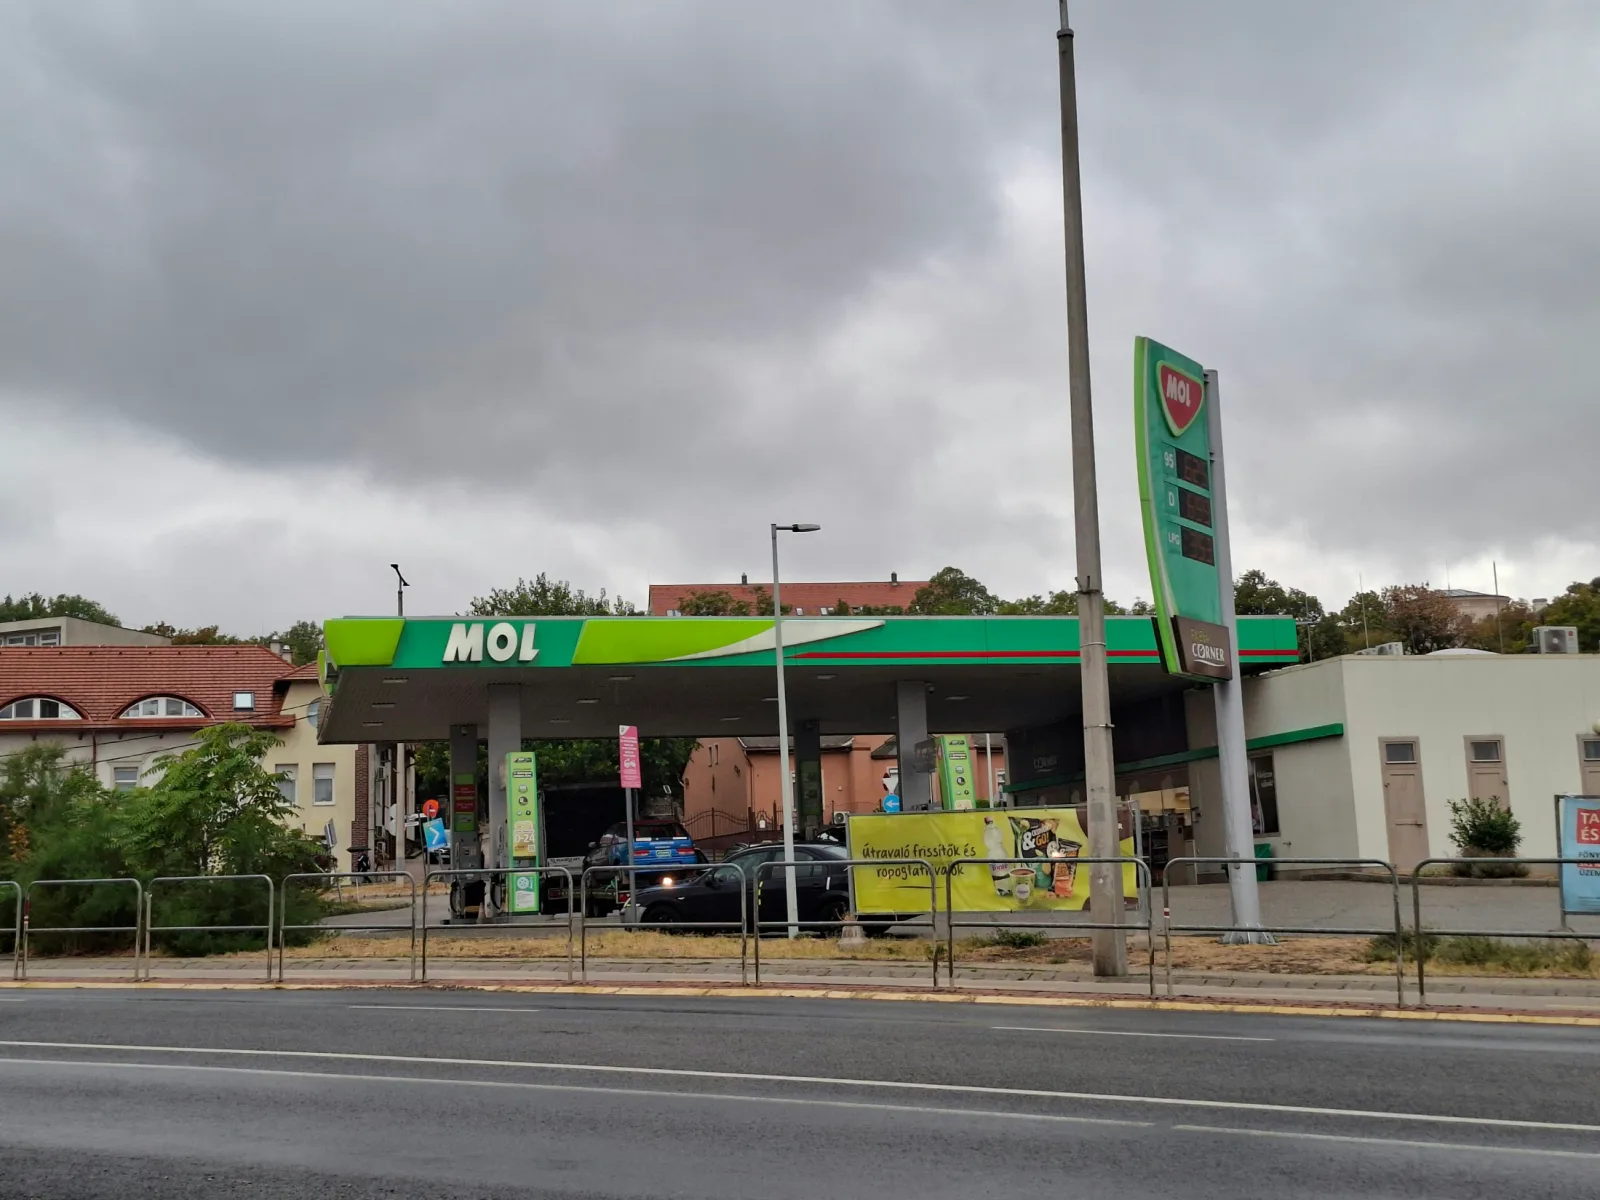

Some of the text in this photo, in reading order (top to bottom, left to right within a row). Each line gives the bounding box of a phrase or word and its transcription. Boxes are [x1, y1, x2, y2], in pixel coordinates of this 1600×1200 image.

[1166, 374, 1191, 408] MOL
[1163, 451, 1174, 469] 95
[1168, 491, 1175, 507] D
[1168, 532, 1180, 546] LPG
[442, 622, 540, 662] MOL
[1191, 643, 1225, 662] CORNER
[1581, 826, 1599, 841] ÉS
[913, 843, 961, 859] frissítők
[963, 843, 977, 858] és
